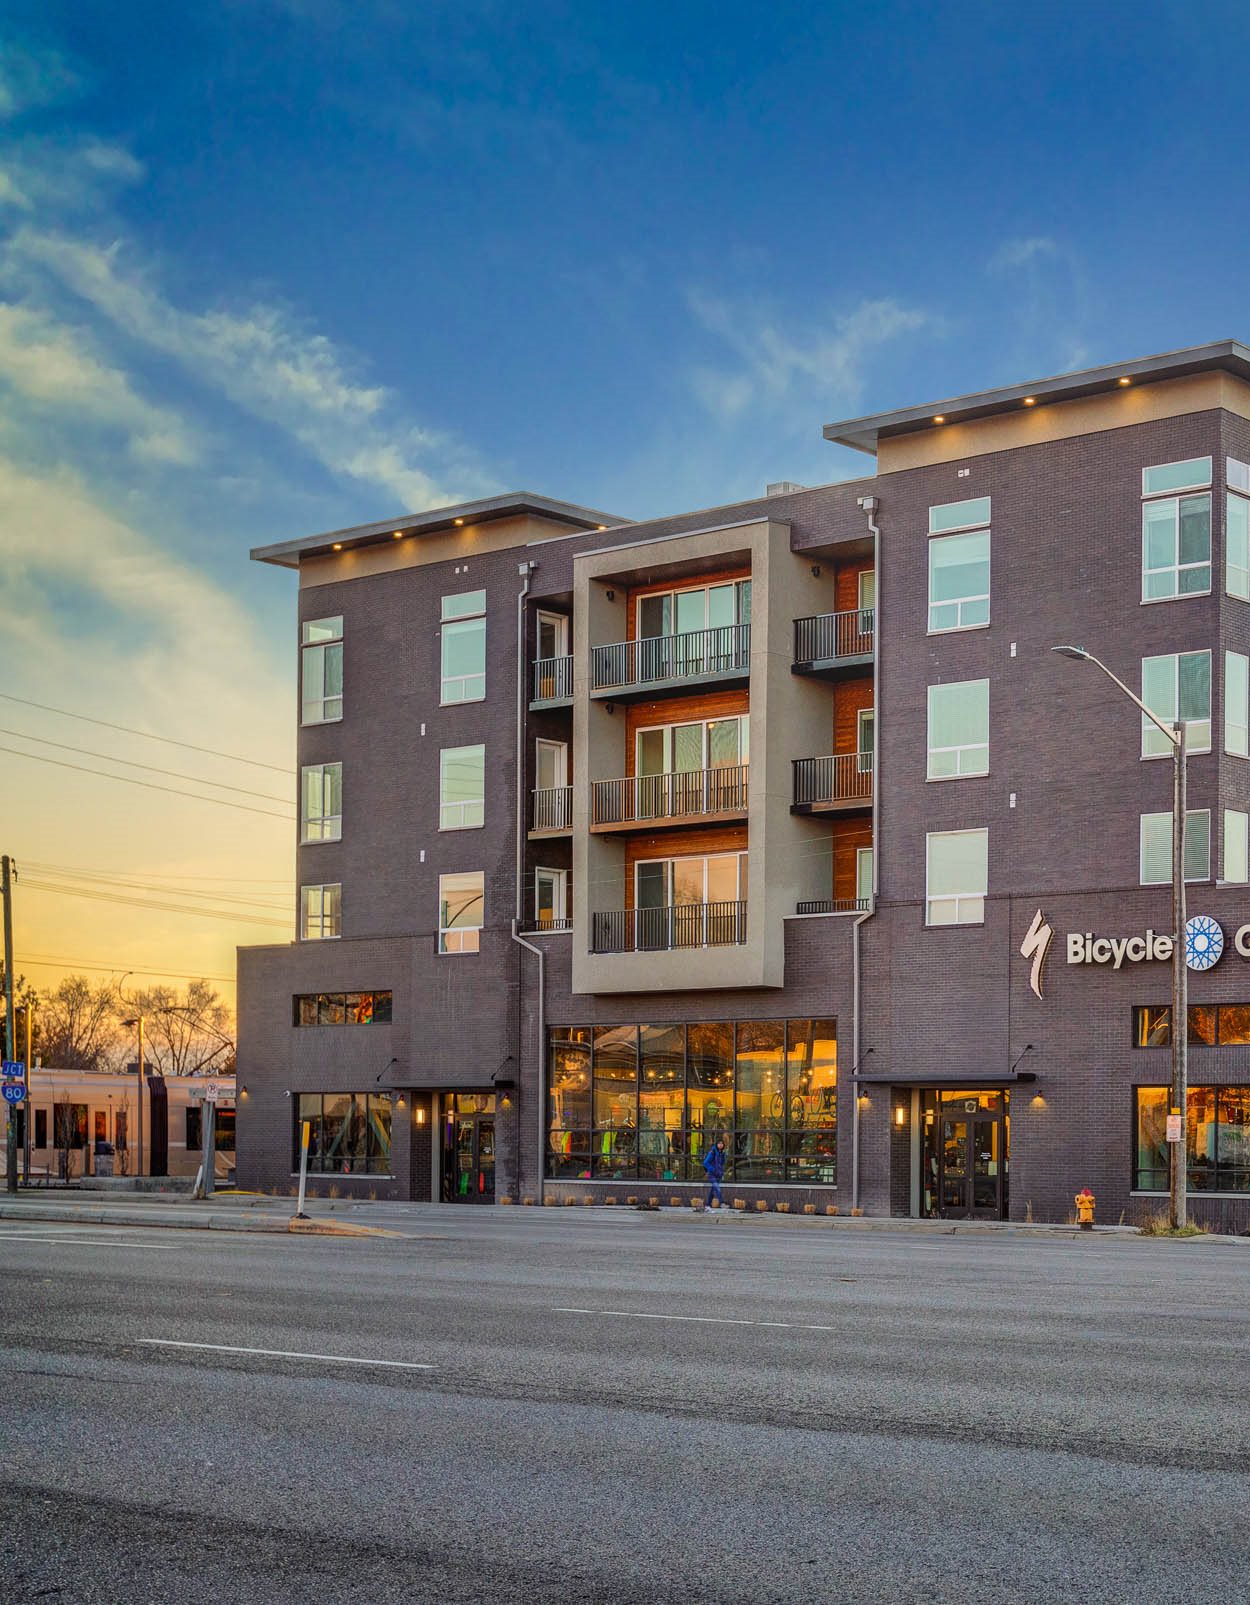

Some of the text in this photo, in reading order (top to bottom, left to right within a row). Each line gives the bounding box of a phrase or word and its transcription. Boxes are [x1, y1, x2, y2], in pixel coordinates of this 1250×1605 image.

[1067, 929, 1174, 970] Bicycle
[4, 1064, 23, 1075] JCT
[5, 1087, 22, 1099] 80
